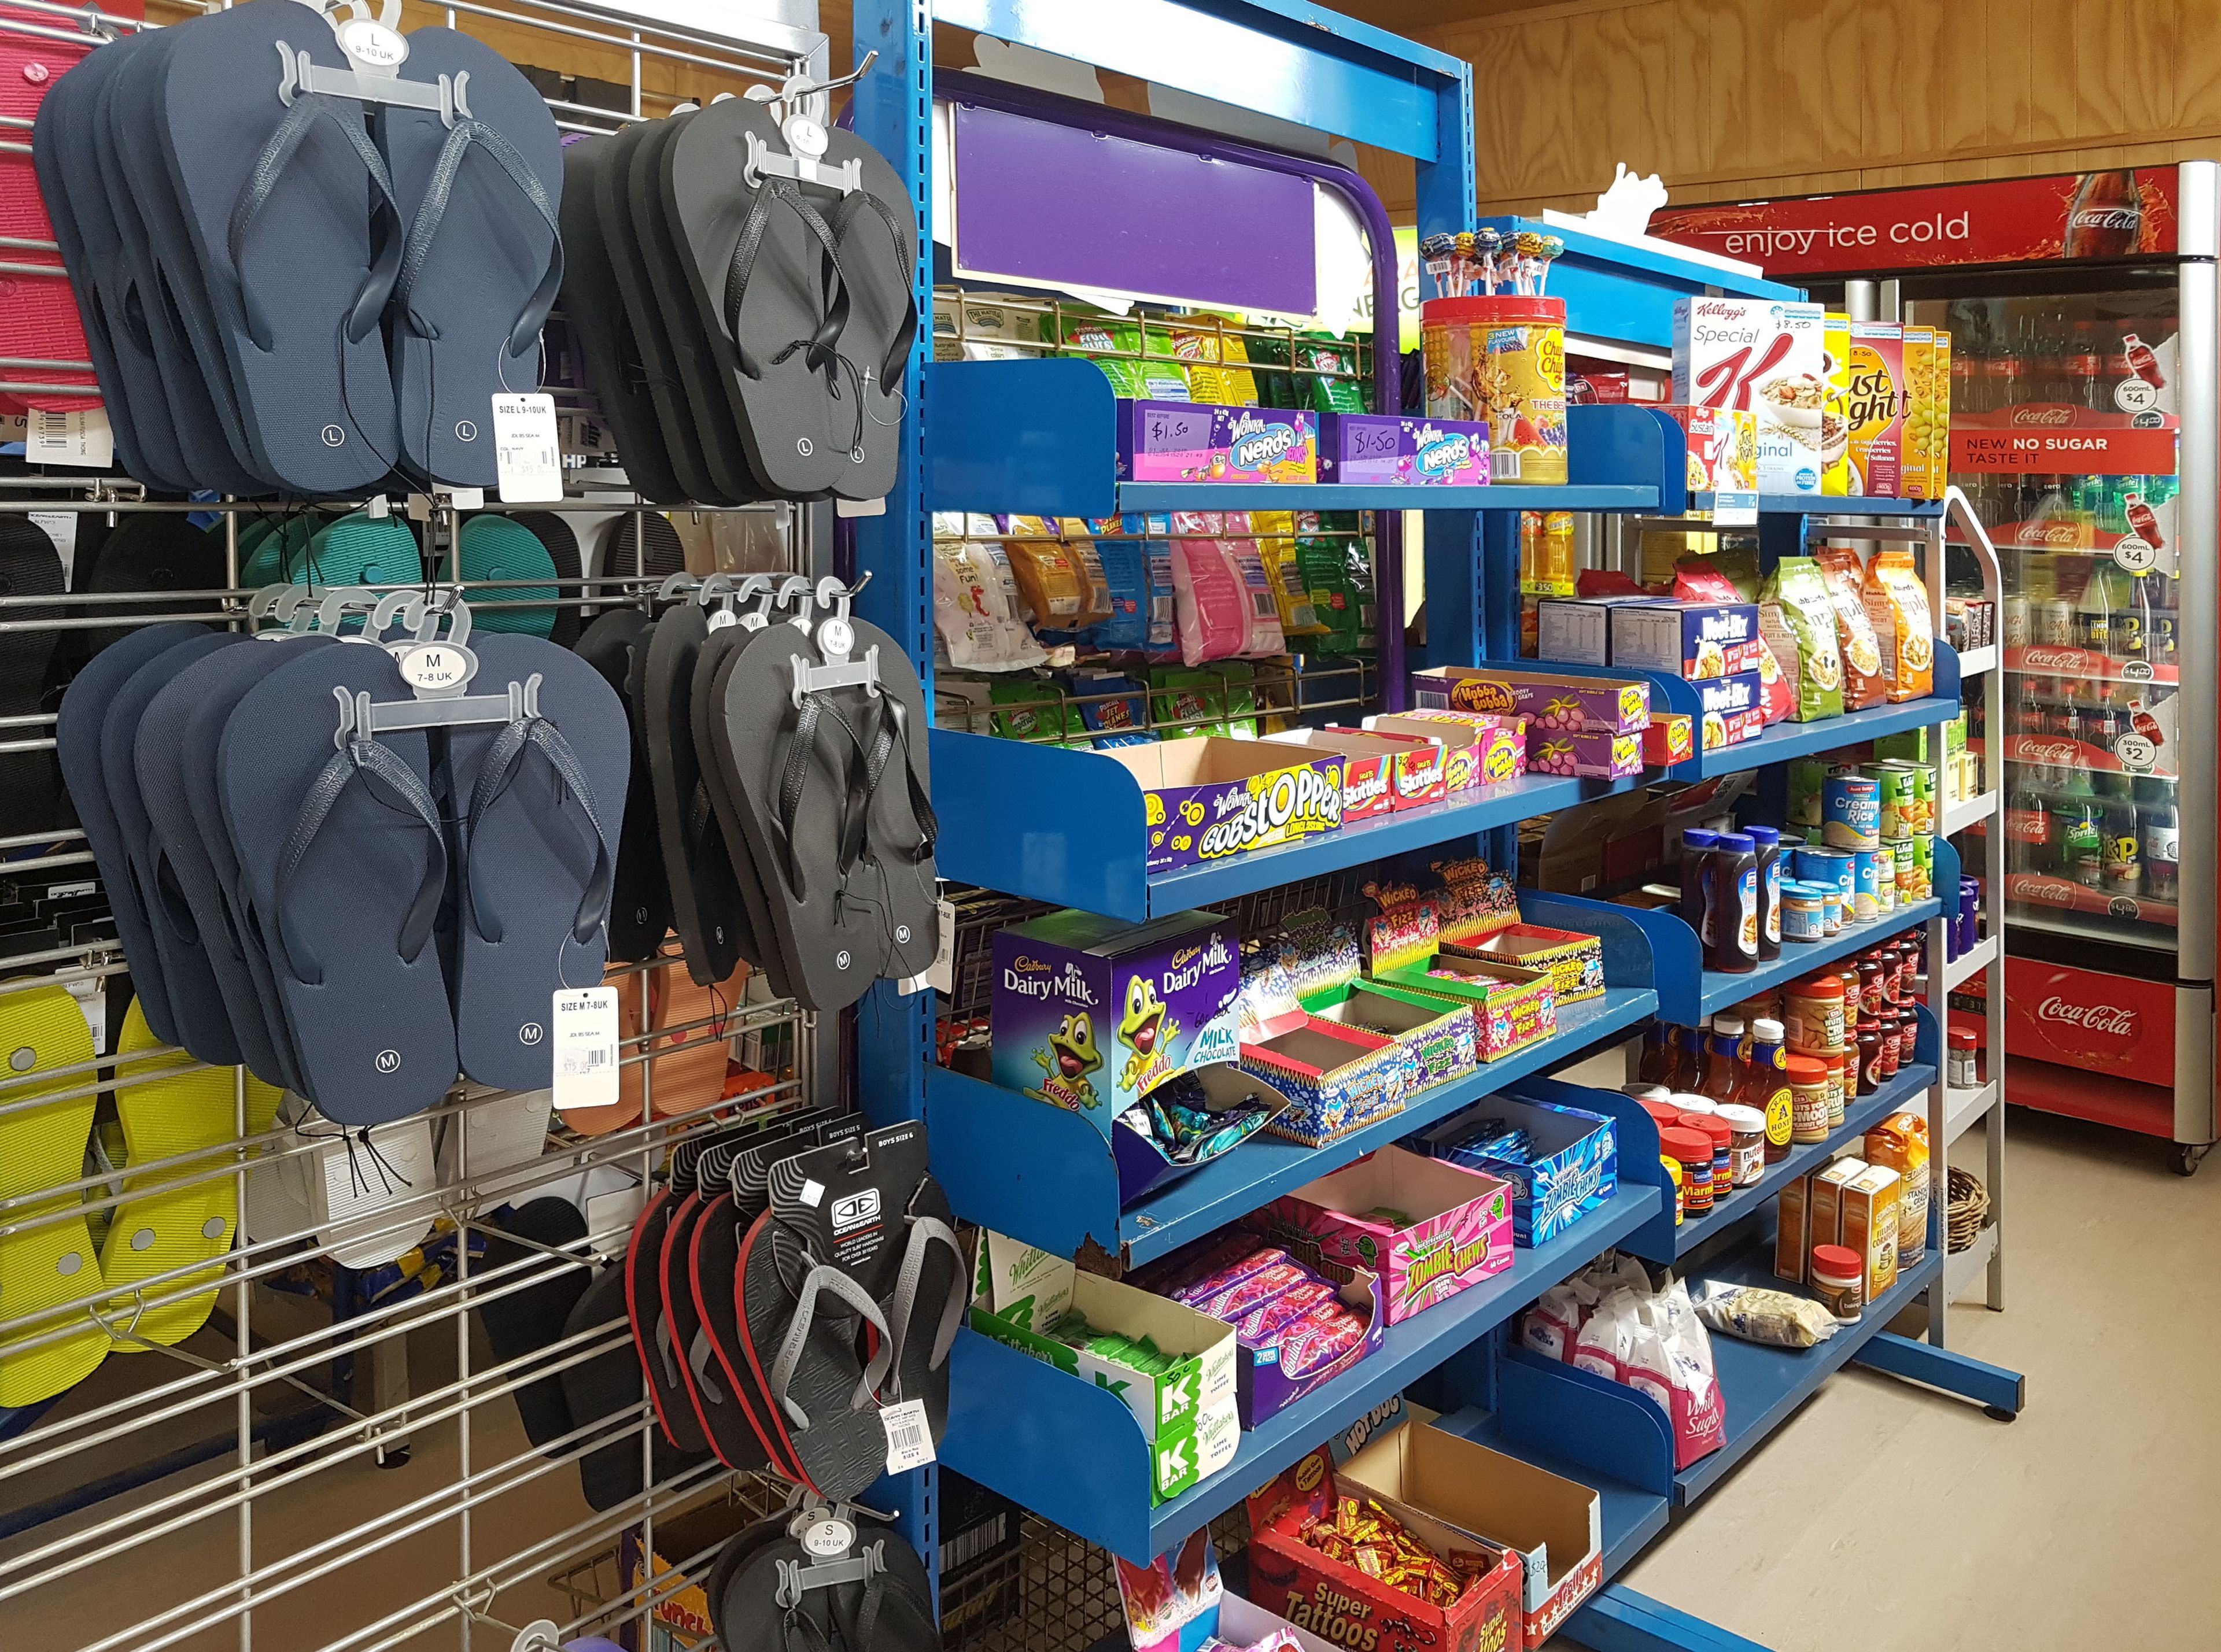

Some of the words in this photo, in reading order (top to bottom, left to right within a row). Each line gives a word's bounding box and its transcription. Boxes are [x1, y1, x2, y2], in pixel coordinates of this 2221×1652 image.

[370, 34, 381, 47] L
[355, 46, 377, 58] 9-10
[377, 49, 394, 61] UK
[2071, 209, 2138, 230] Coca-Cola
[1725, 226, 1815, 258] enjoy
[1828, 221, 1877, 247] ice
[1890, 211, 1969, 242] cold
[1696, 302, 1747, 320] Kellogg's
[1776, 319, 1811, 330] $8.50
[1495, 330, 1515, 338] NEW
[1694, 324, 1759, 345] Special
[1531, 400, 1551, 410] THE
[2126, 393, 2145, 405] $4
[499, 405, 515, 414] SIZE
[516, 406, 521, 414] L
[522, 406, 547, 414] 9-10UK
[2013, 408, 2072, 424] Coca-Cola
[1151, 422, 1189, 442] $1.50
[1739, 430, 1752, 445] Just
[1967, 438, 2006, 449] NEW
[2012, 438, 2039, 450] NO
[2045, 438, 2108, 450] SUGAR
[1739, 445, 1754, 463] Right
[1967, 453, 2018, 464] TASTE
[2025, 453, 2039, 464] IT
[2018, 526, 2078, 542] Coca-Cola
[2125, 551, 2143, 564] $4
[955, 566, 974, 575] some
[960, 574, 979, 585] Fun!
[720, 616, 726, 624] M
[751, 618, 758, 627] M
[2090, 621, 2108, 630] LEMON
[835, 626, 842, 636] M
[427, 655, 441, 668] M
[2025, 650, 2085, 669] Coca-Cola
[417, 673, 434, 682] 7-8
[437, 672, 452, 682] UK
[1460, 686, 1497, 702] Hubba
[1472, 694, 1509, 711] Bubba
[1518, 693, 1534, 701] GRAPE
[1105, 707, 1119, 719] JET
[2019, 740, 2077, 759] Coca-Cola
[2123, 740, 2150, 748] 300mL
[2126, 748, 2143, 761] $2
[1400, 767, 1444, 797] Skittles
[1343, 778, 1388, 808] Skittles
[1847, 810, 1875, 825] Rice
[2067, 826, 2097, 840] Sprite
[1443, 860, 1487, 881] WICKED
[1379, 886, 1416, 907] WICKED
[1455, 881, 1486, 900] FIZZ
[2014, 879, 2071, 901] Coca-Cola
[1390, 911, 1415, 928] FIZZ
[1014, 956, 1052, 974] Cadbury
[1172, 944, 1202, 970] Cadbury
[1163, 960, 1202, 994] Dairy
[1202, 944, 1233, 976] Milk
[1004, 969, 1056, 1001] Dairy
[1054, 976, 1098, 1006] Milk
[561, 1001, 578, 1011] SIZE
[579, 1001, 585, 1010] M
[586, 1000, 608, 1010] 7-8UK
[1509, 999, 1541, 1021] WICKED
[2038, 995, 2138, 1037] Coca-Cola
[1515, 1018, 1538, 1035] FIZZ
[1199, 1028, 1233, 1051] MILK
[1421, 1036, 1455, 1060] WICKED
[1194, 1045, 1237, 1065] CHOCOLATE
[1135, 1054, 1172, 1093] Freddo
[1042, 1077, 1082, 1111] Freddo
[1348, 1073, 1385, 1101] WICKED
[829, 1129, 844, 1139] BOYS
[844, 1126, 856, 1135] SIZE
[878, 1137, 895, 1148] BOYS
[895, 1133, 909, 1143] SIZE
[1545, 1171, 1578, 1220] ZOMBIE
[1576, 1163, 1601, 1202] CHEWS
[1408, 1241, 1455, 1295] ZOMBIE
[1453, 1234, 1489, 1274] CHEWS
[1496, 1255, 1510, 1266] Count
[1256, 1352, 1263, 1365] 2
[1210, 1378, 1230, 1394] TOFFEE
[1213, 1373, 1227, 1385] LIME
[1161, 1373, 1193, 1417] K
[1161, 1402, 1190, 1426] BAR
[1213, 1437, 1228, 1449] LIME
[1344, 1420, 1374, 1458] HOT
[1210, 1443, 1233, 1459] TOFFEE
[1159, 1436, 1190, 1484] K
[1161, 1467, 1188, 1493] BAR
[825, 1525, 833, 1535] S
[1315, 1581, 1373, 1620] Super
[1286, 1590, 1379, 1652] Tattoos
[1479, 1607, 1506, 1643] Super
